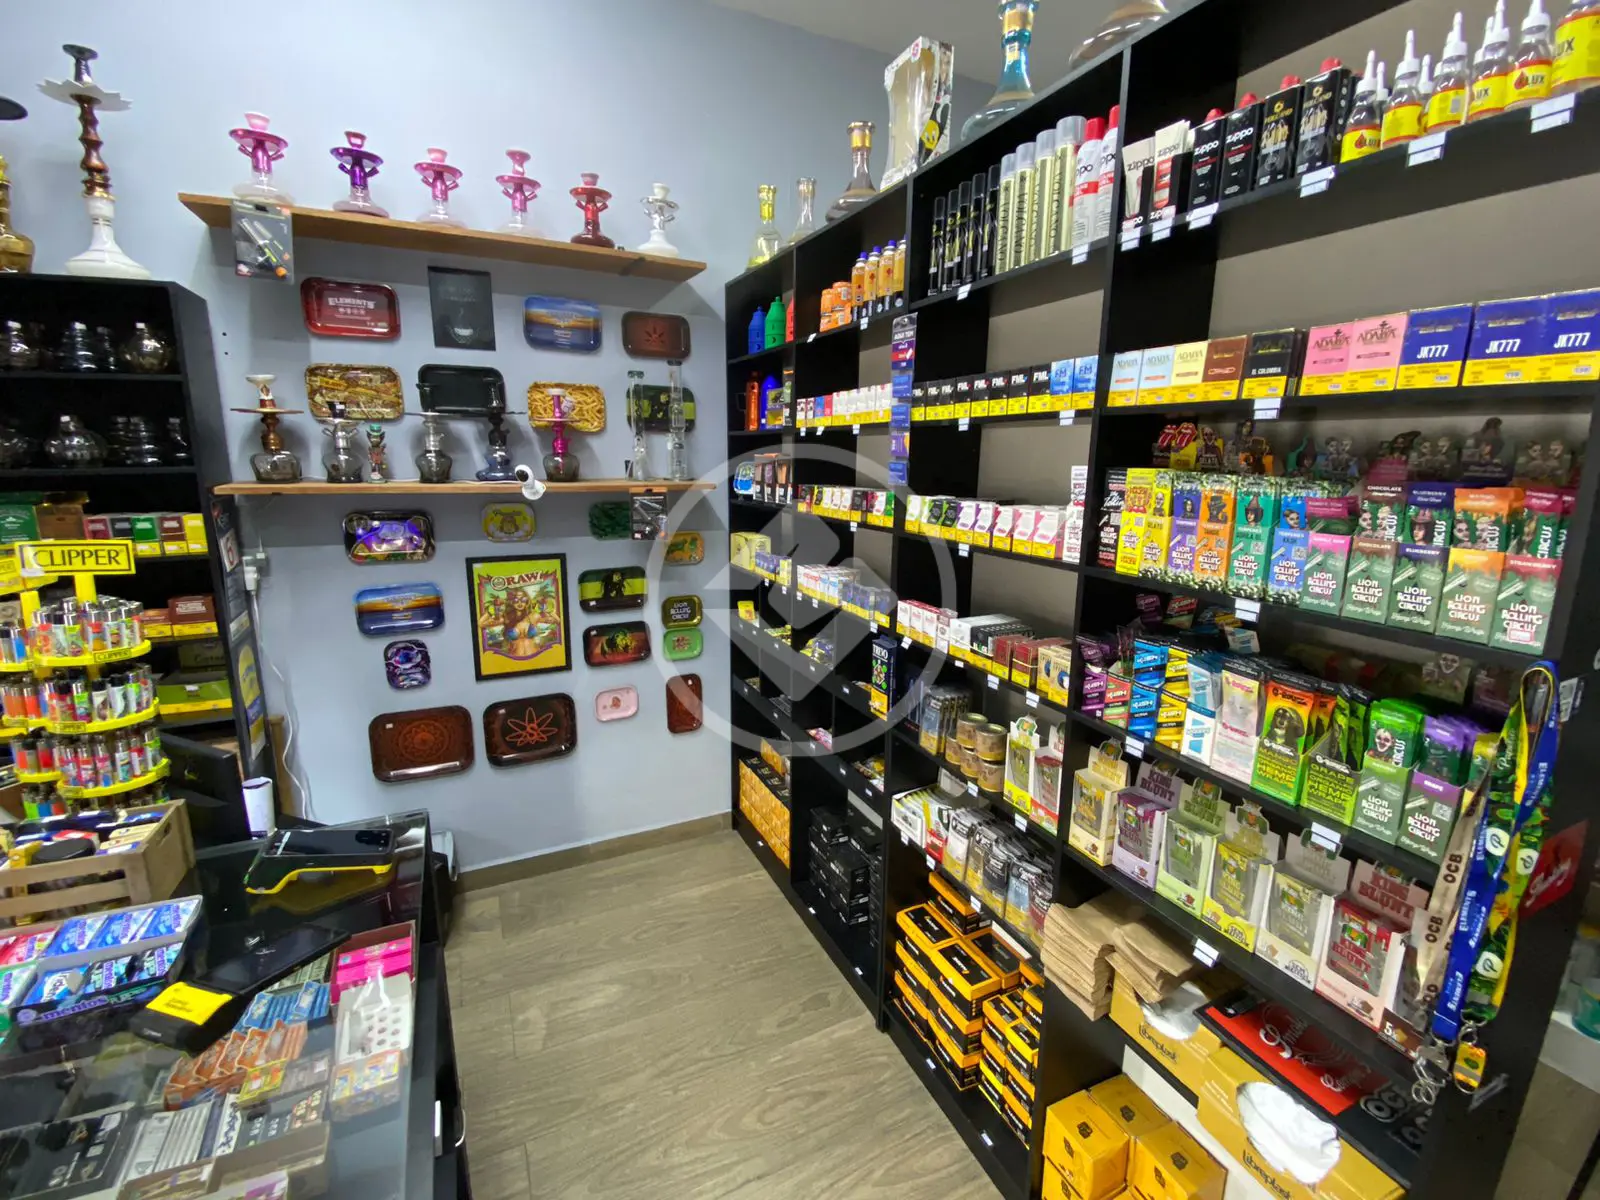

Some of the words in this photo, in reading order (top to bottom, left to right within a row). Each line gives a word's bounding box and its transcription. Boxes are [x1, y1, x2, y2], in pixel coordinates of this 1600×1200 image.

[1225, 127, 1254, 144] zippo
[1193, 139, 1219, 157] zippo
[1486, 338, 1521, 354] JK777
[1554, 332, 1591, 349] JK777
[1416, 344, 1449, 359] JK777
[33, 549, 122, 567] CLIPPER
[506, 571, 542, 586] RAW
[1510, 603, 1537, 613] LION
[1501, 610, 1543, 625] ROLLING
[1503, 620, 1536, 633] CIRCUS
[1443, 854, 1462, 884] OCB
[1425, 915, 1444, 943] OCB
